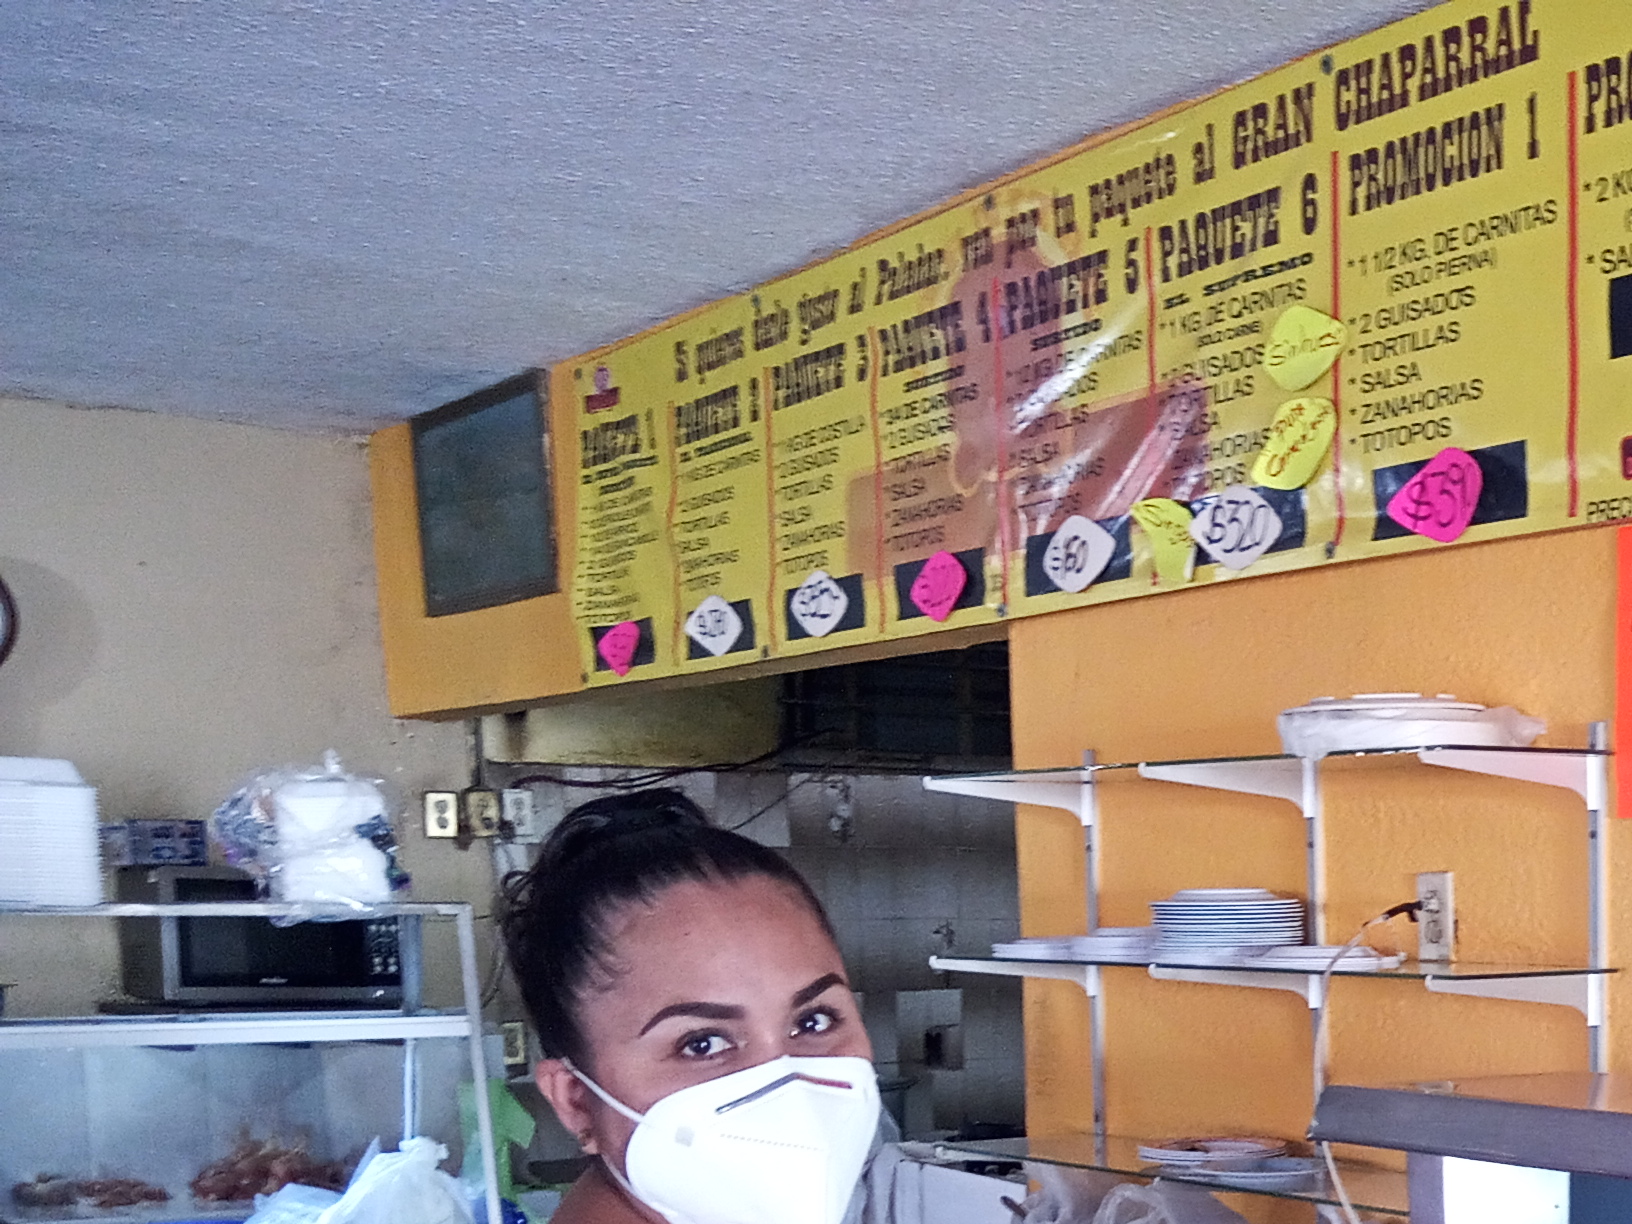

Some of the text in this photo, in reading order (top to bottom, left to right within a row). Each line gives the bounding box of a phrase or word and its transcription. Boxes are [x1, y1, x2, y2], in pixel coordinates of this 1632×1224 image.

[1088, 150, 1177, 238] paquete
[1192, 122, 1216, 185] al
[1232, 81, 1313, 170] GRAN
[1334, 0, 1540, 131] CHAPARRAL
[1348, 91, 1541, 217] PROMOCION 1
[1597, 177, 1610, 203] 2
[1158, 172, 1319, 283] PAQUETE 6
[1433, 227, 1460, 256] DE
[1462, 198, 1559, 247] CARNITAS
[1005, 235, 1140, 341] PAQUETE 5
[1204, 303, 1227, 328] DE
[1227, 278, 1309, 321] CARNITAS
[1358, 285, 1477, 335] 2 GUISADOS
[1181, 343, 1265, 384] GUISADOS
[1358, 321, 1462, 364] TORTILLAS
[1359, 361, 1423, 394] SALSA
[1359, 378, 1486, 425] ZANAHORIAS
[1359, 416, 1453, 455] TOTOPOS
